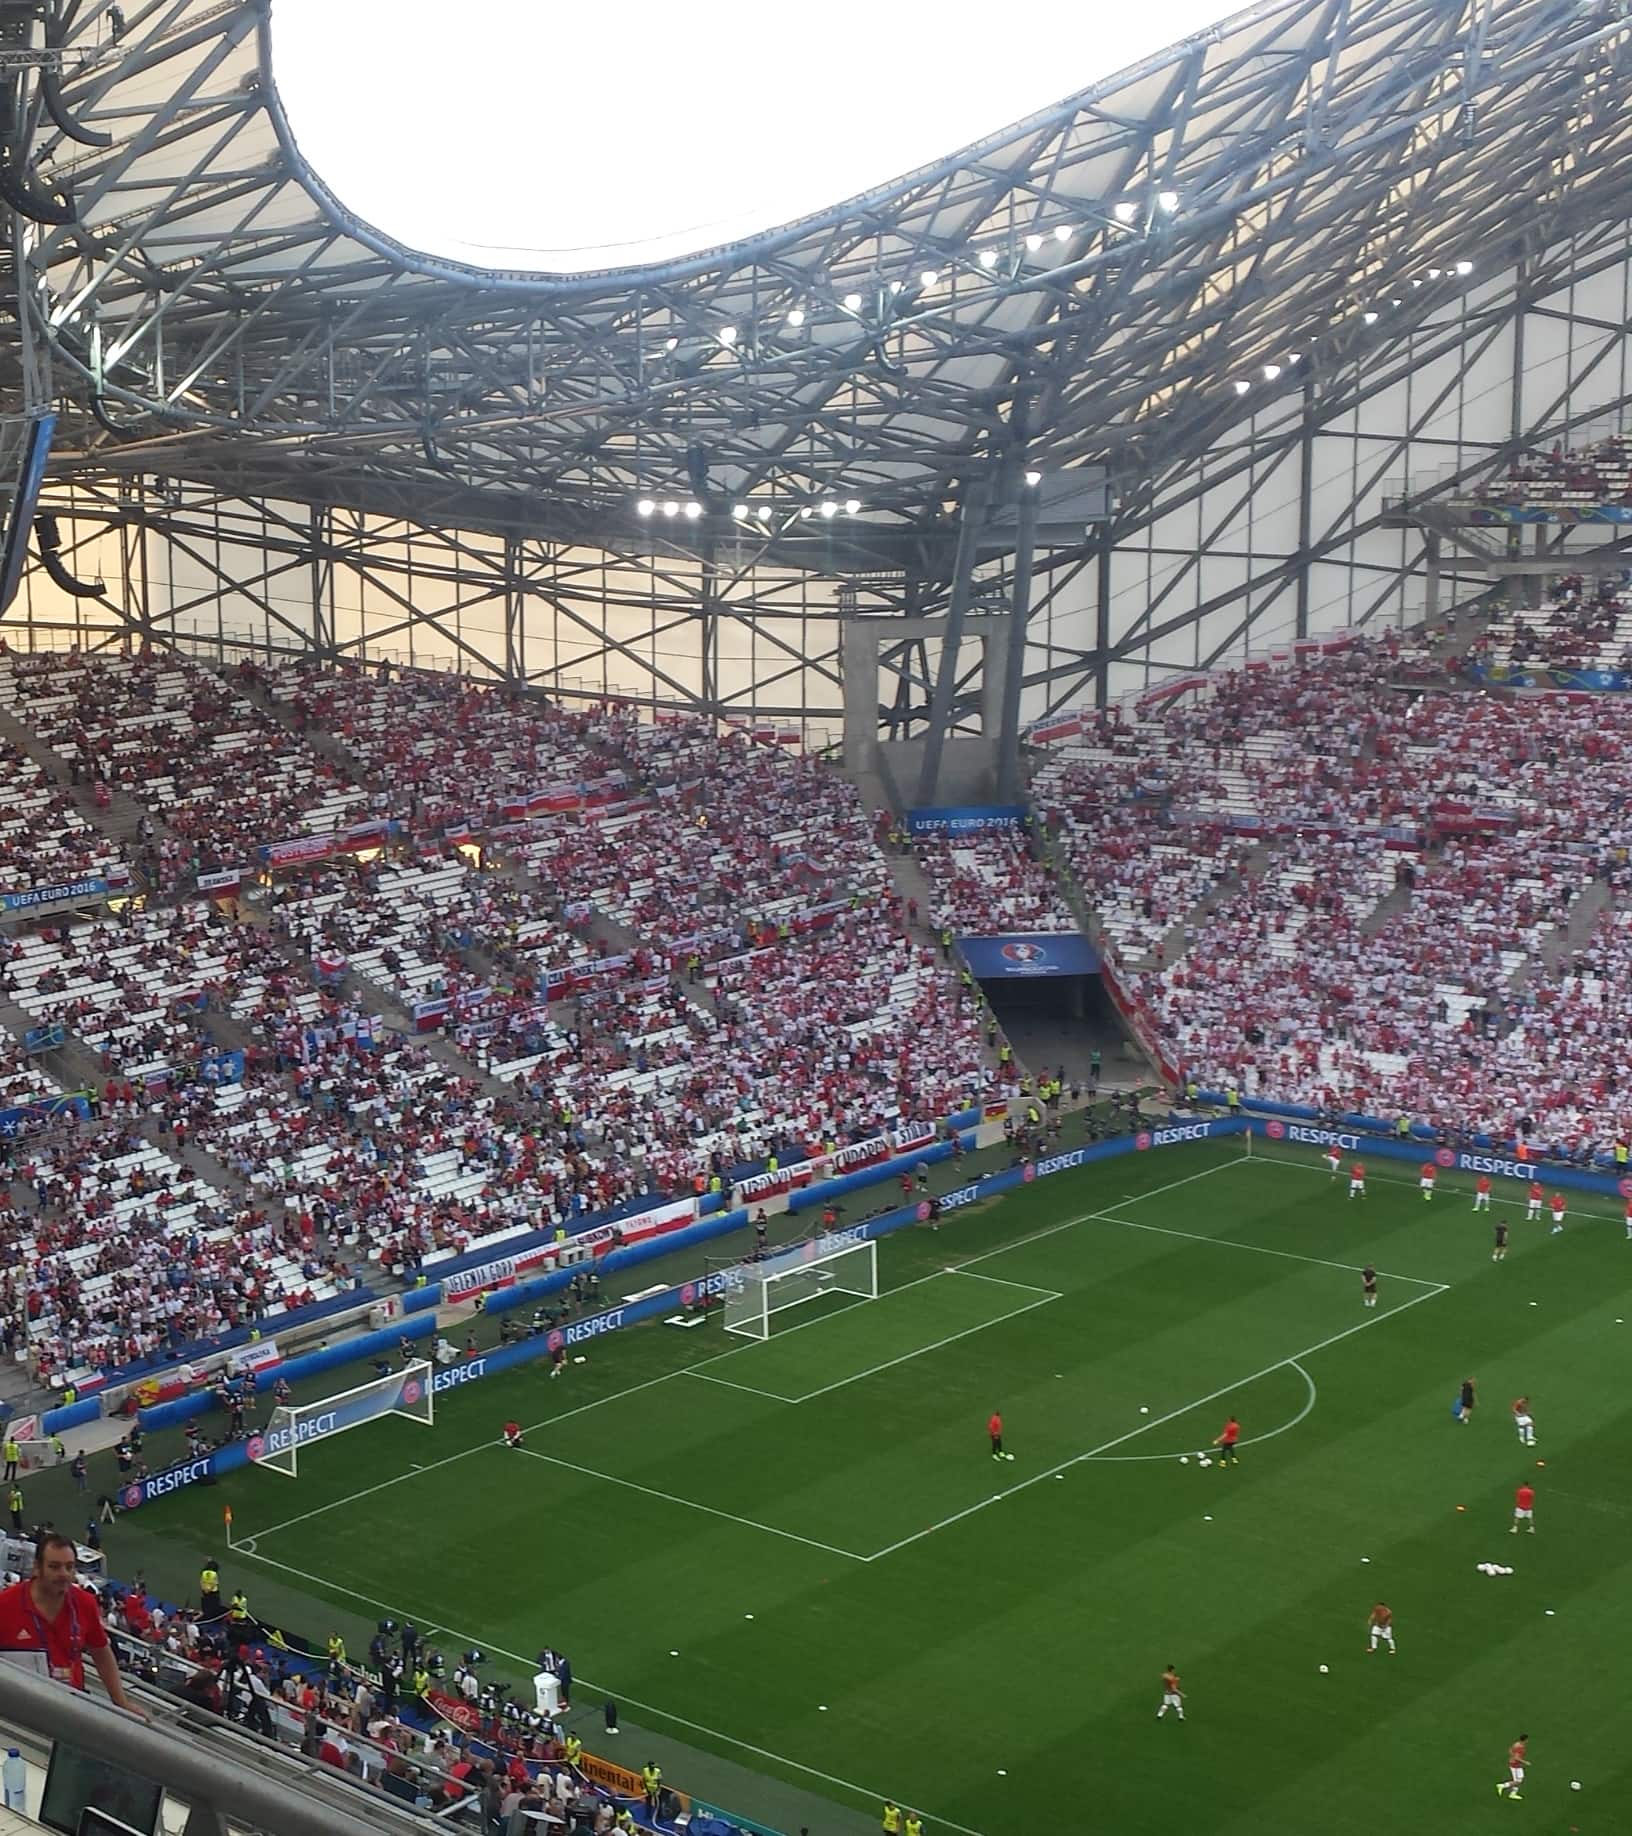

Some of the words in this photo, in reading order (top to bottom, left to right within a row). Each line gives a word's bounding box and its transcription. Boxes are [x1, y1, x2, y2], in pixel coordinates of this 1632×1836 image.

[916, 820, 947, 830] UEFA
[951, 818, 985, 828] EURO
[987, 816, 1018, 827] 2016
[12, 892, 40, 906] UEFA
[41, 886, 69, 900] EURO
[71, 881, 96, 894] 2016
[1153, 1123, 1210, 1145] RESPECT
[1289, 1126, 1360, 1150] RESPECT
[1037, 1150, 1085, 1176] RESPECT
[1460, 1153, 1537, 1180] RESPECT
[817, 1224, 869, 1253] RESPECT
[567, 1310, 624, 1343] RESPECT
[270, 1412, 337, 1451] RESPECT
[146, 1459, 210, 1499] RESPECT
